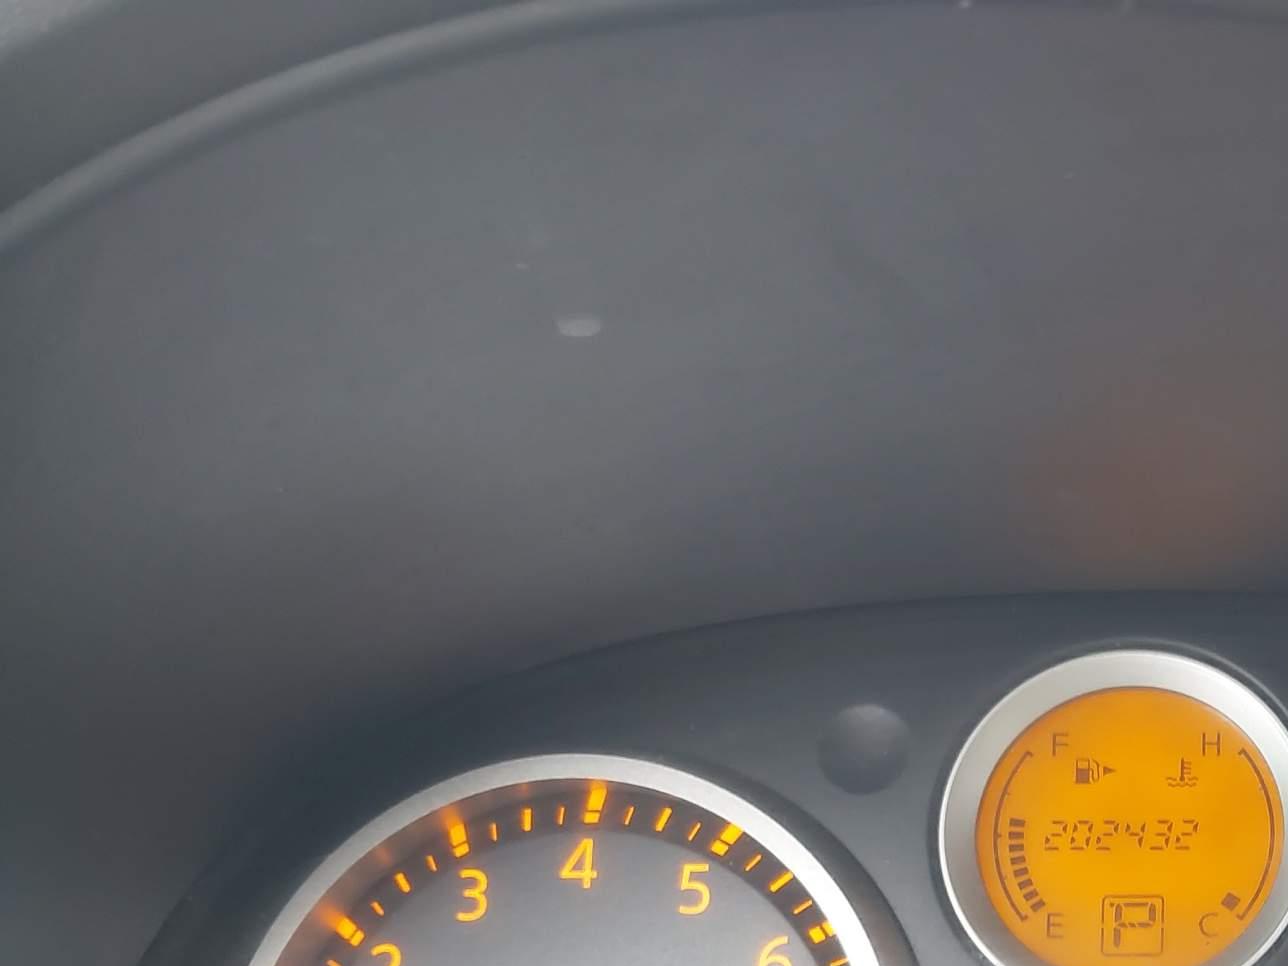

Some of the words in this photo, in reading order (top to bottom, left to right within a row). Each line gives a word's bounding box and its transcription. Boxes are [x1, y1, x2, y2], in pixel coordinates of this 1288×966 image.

[1051, 732, 1069, 757] F
[1201, 732, 1222, 756] H
[1043, 818, 1200, 851] 202432
[559, 838, 598, 889] 4
[455, 870, 489, 923] 3
[678, 864, 712, 916] 5
[1046, 912, 1065, 939] E
[1108, 901, 1157, 949] P
[1199, 912, 1219, 938] C
